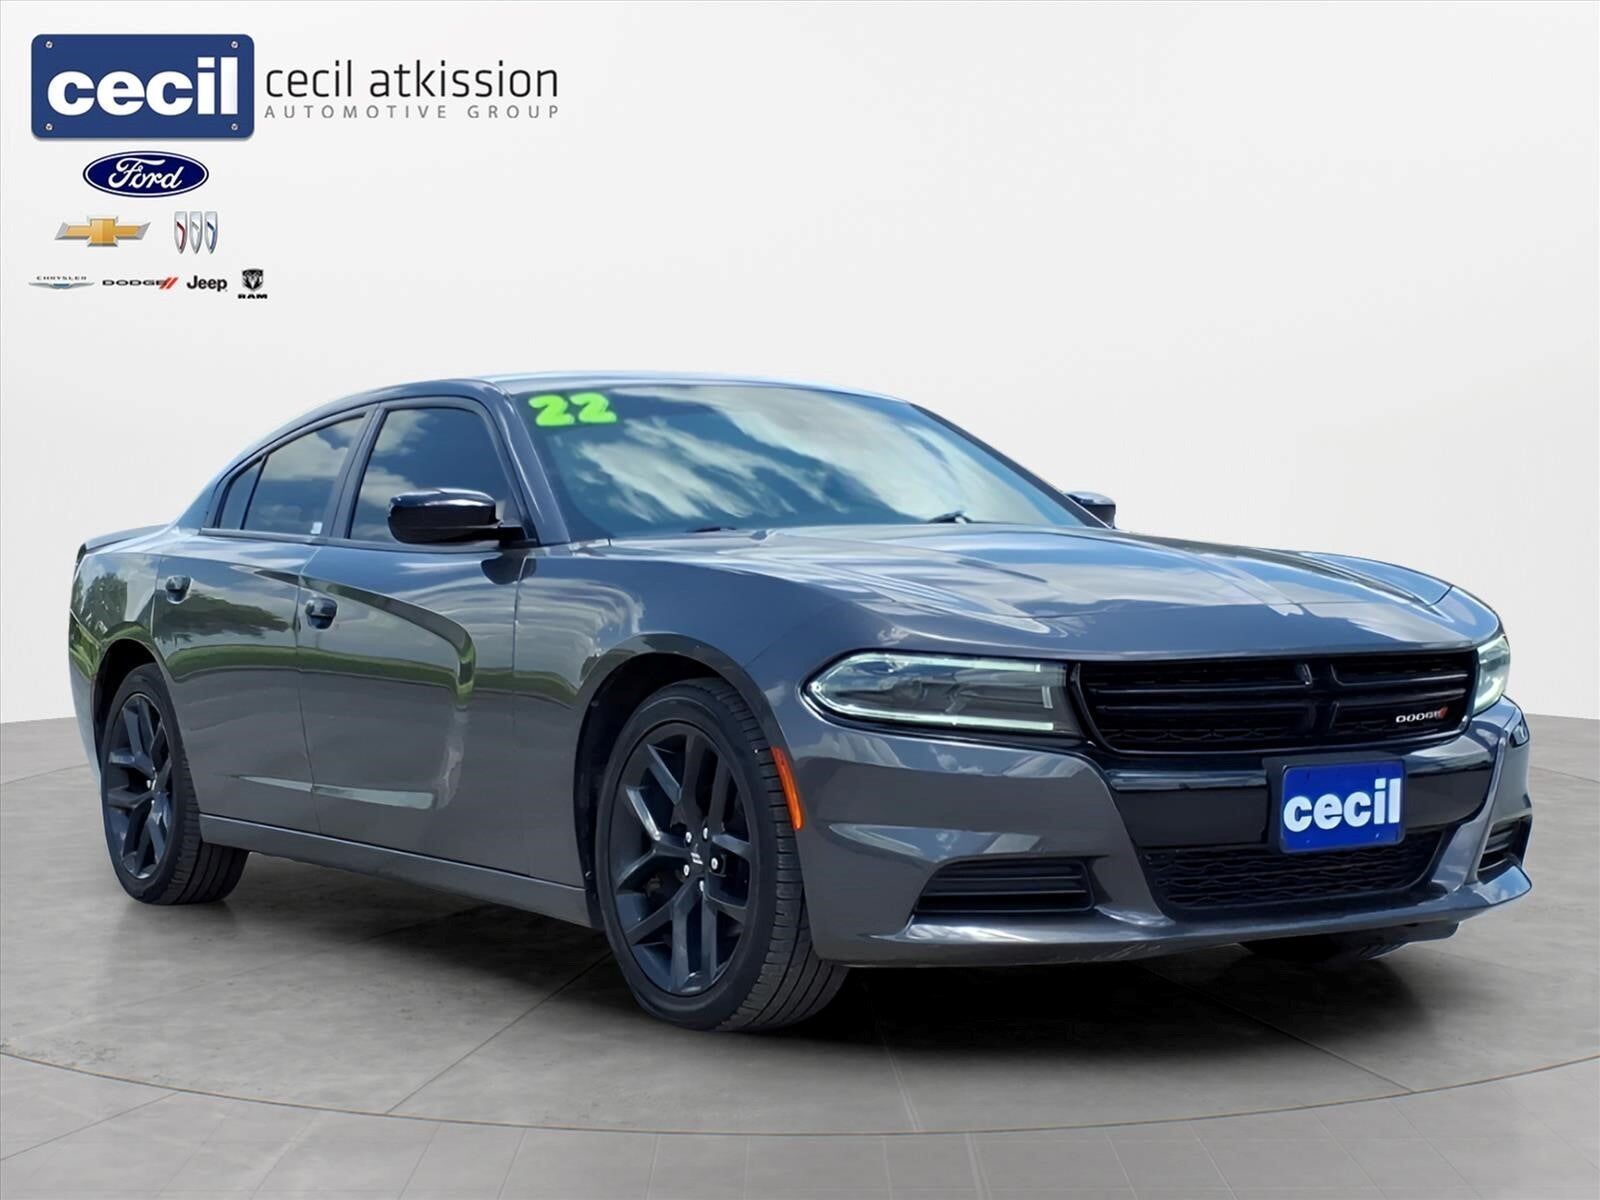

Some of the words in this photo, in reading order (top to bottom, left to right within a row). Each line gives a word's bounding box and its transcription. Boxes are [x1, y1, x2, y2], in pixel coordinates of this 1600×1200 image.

[528, 392, 617, 426] 22
[1395, 709, 1442, 723] DODGE
[1283, 777, 1402, 833] cecil
